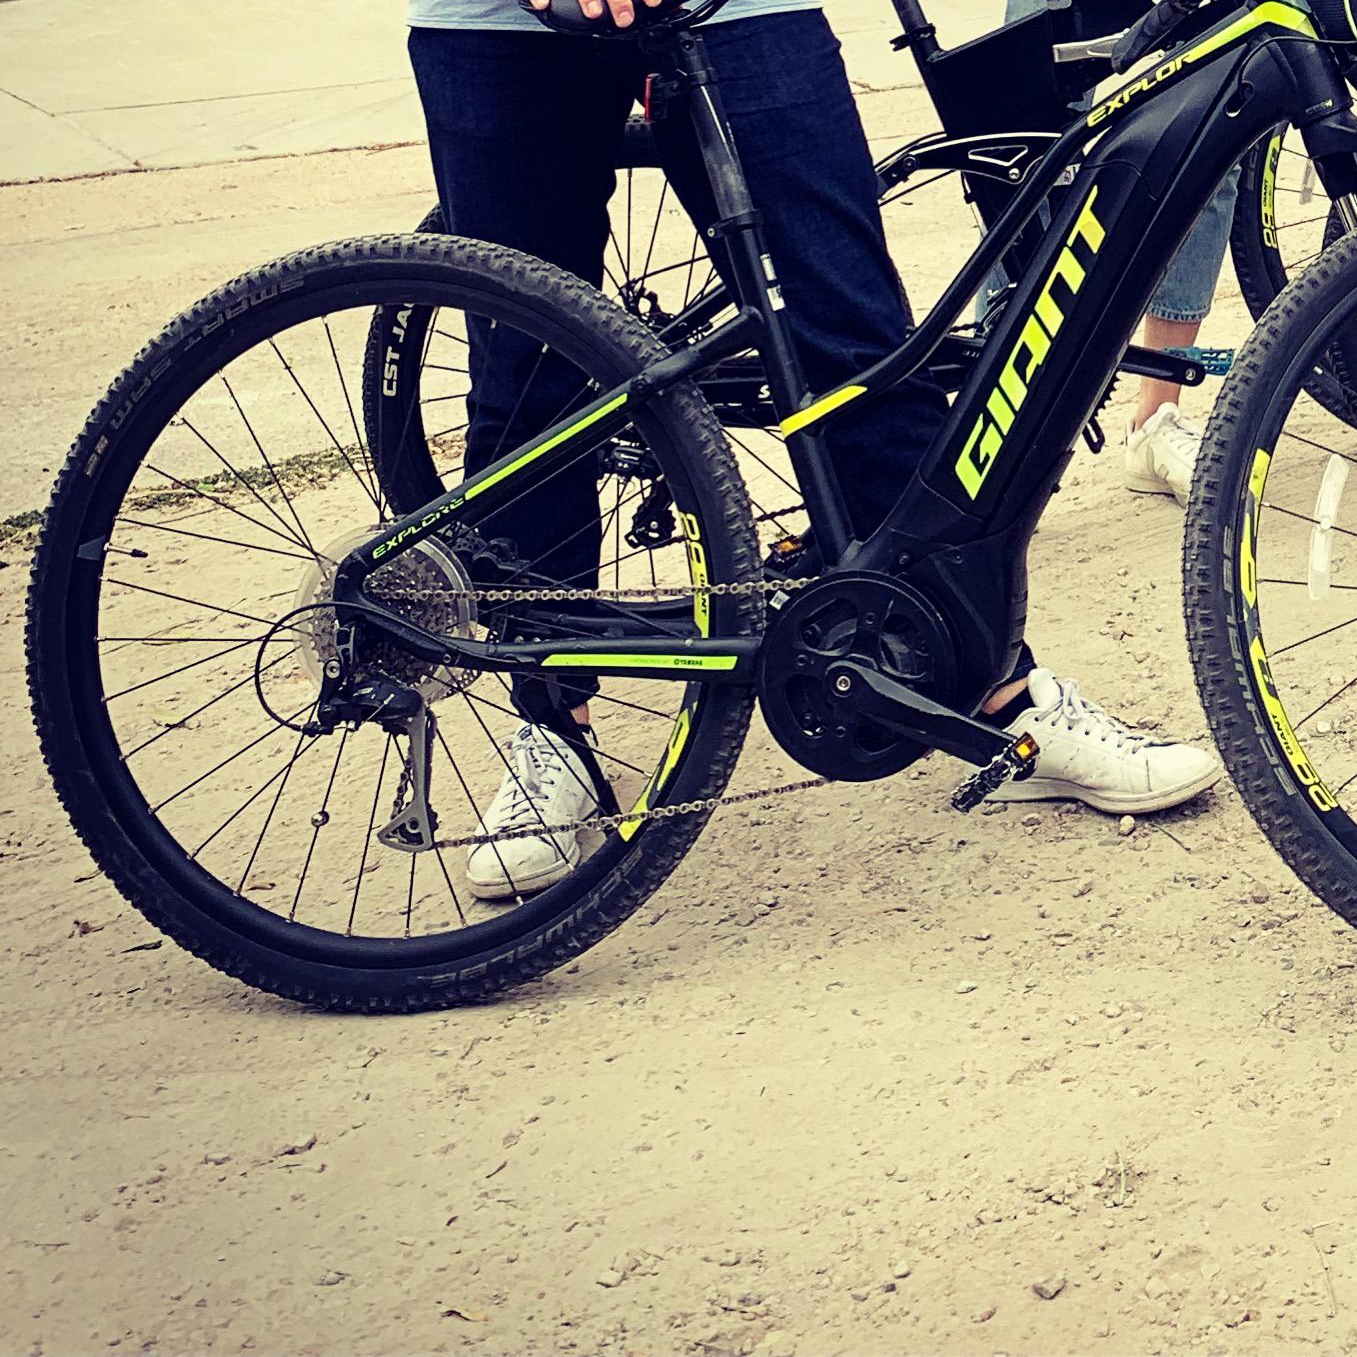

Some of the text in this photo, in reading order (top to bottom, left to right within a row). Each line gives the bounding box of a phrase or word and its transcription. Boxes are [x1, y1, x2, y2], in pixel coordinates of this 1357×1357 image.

[383, 303, 415, 397] CST JA
[955, 184, 1106, 501] GIANT
[372, 497, 465, 560] EXPLORE
[1222, 524, 1296, 795] SCHWALBE
[1271, 713, 1294, 756] GIANT
